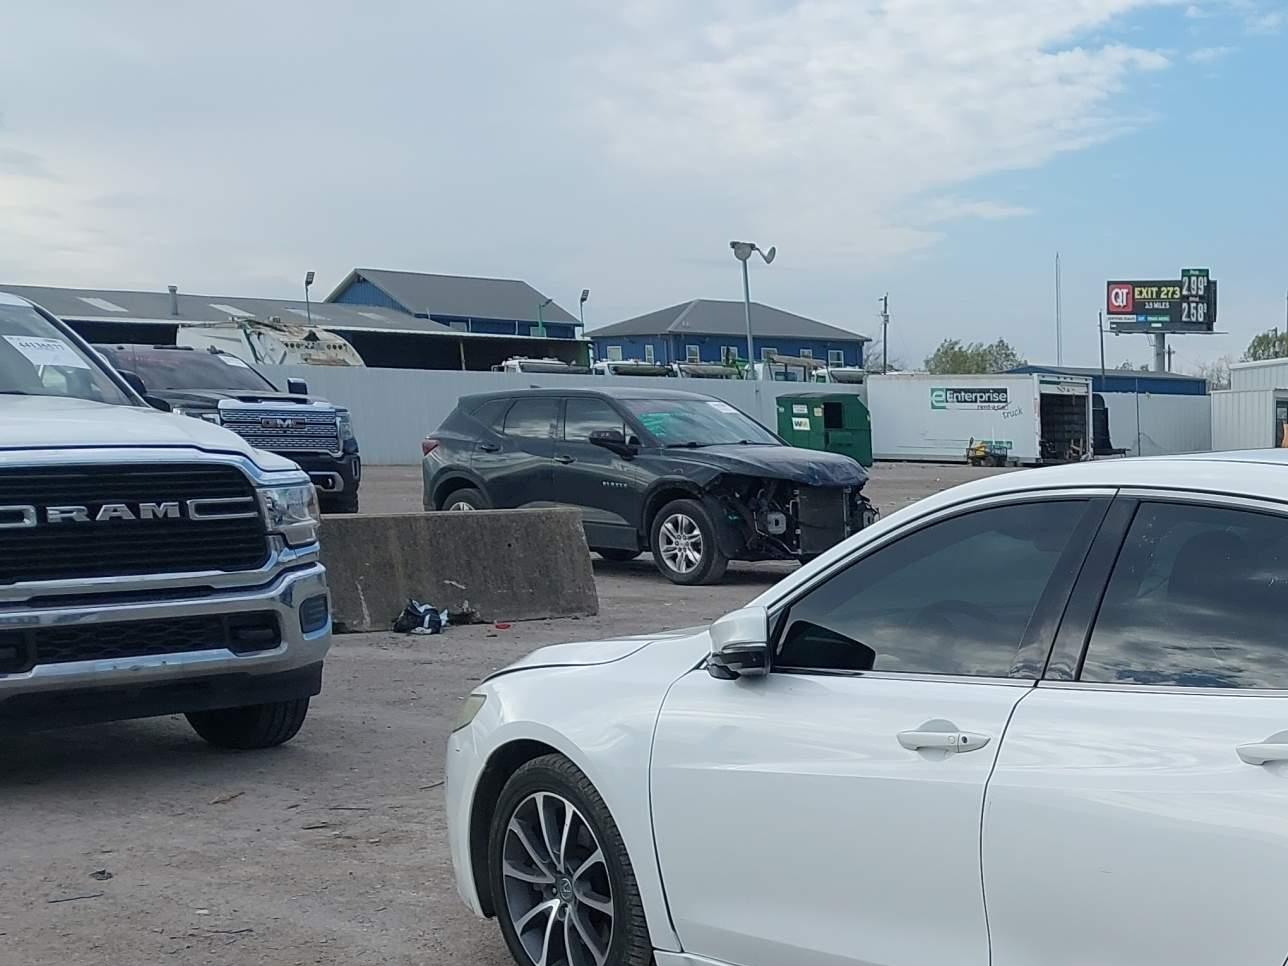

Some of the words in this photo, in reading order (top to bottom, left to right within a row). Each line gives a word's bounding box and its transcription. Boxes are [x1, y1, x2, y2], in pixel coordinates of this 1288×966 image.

[1111, 289, 1129, 308] QT
[1134, 287, 1158, 298] EXIT
[1160, 287, 1180, 298] 273
[946, 390, 1007, 404] Enterprise
[1002, 407, 1024, 420] truck
[261, 418, 305, 429] GMC
[46, 502, 180, 523] RAM
